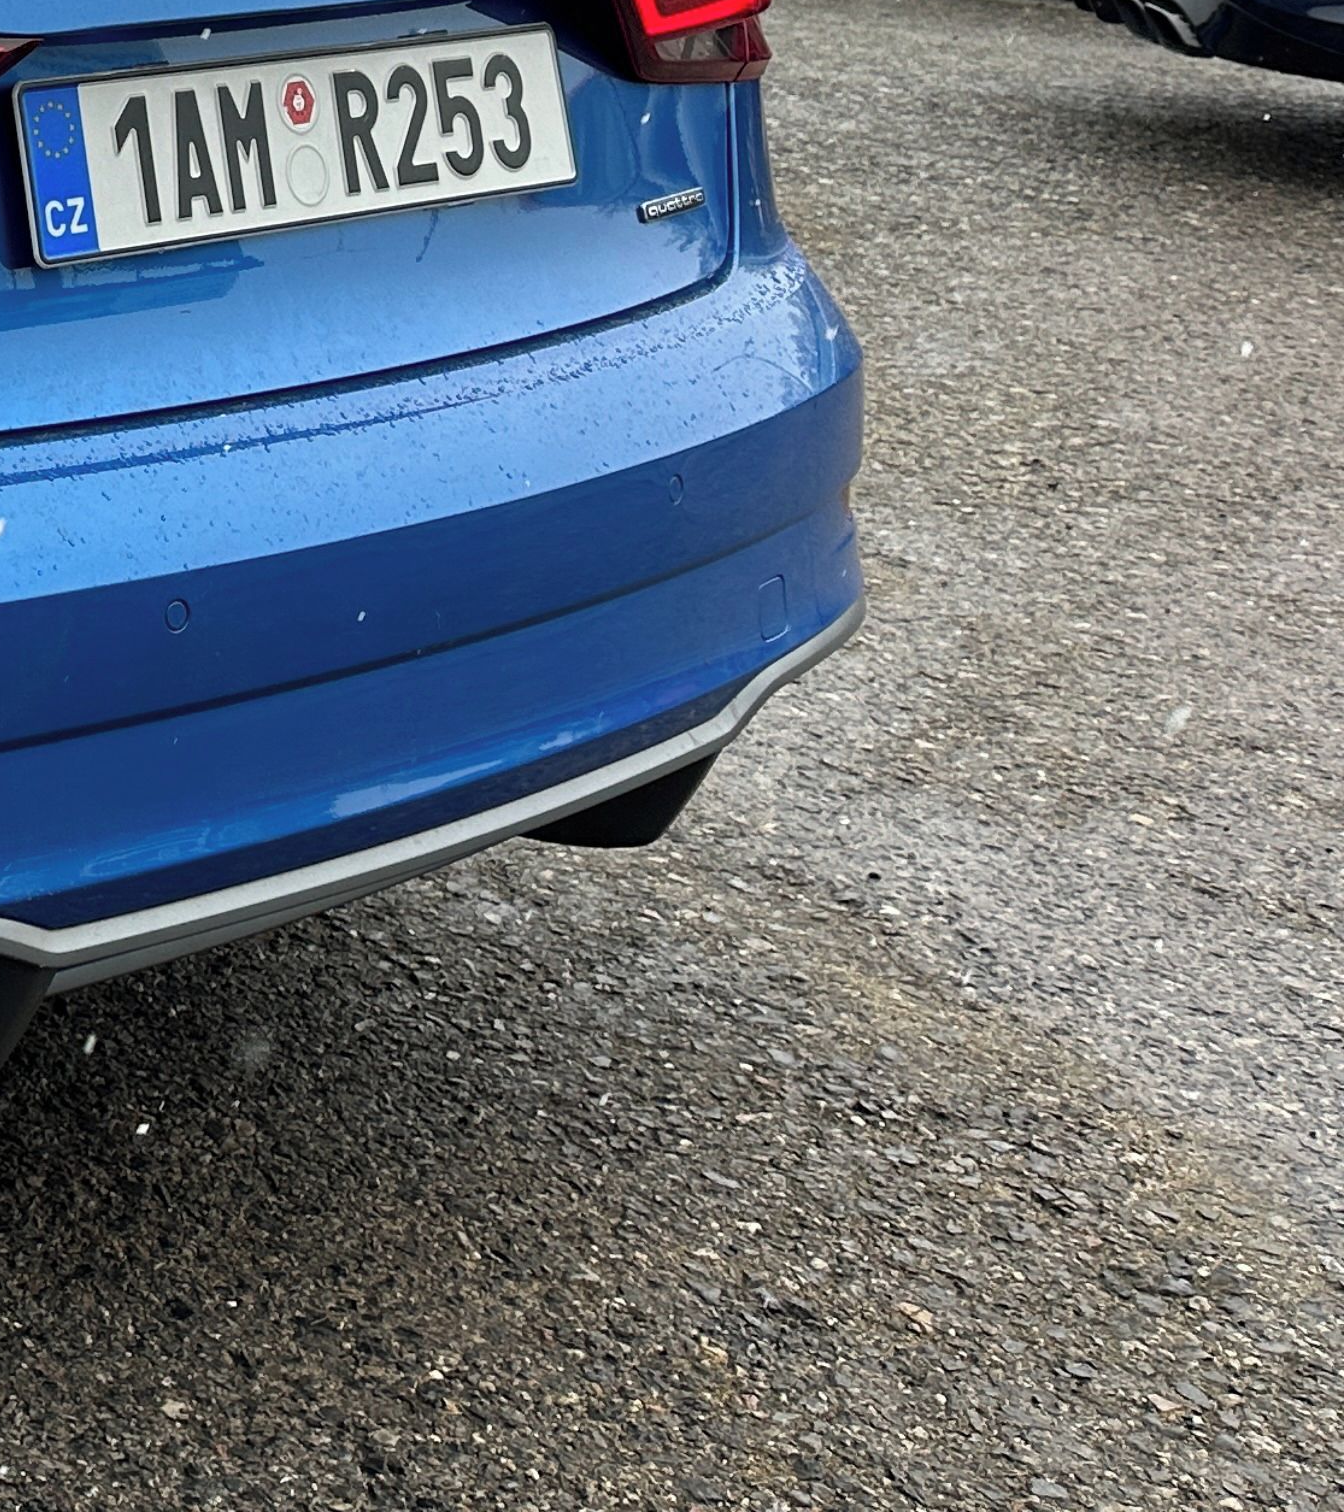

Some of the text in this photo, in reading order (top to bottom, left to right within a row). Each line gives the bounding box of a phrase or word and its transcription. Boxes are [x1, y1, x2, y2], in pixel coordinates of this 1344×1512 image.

[113, 54, 533, 226] 1AM R253
[44, 196, 89, 239] CZ
[647, 192, 704, 217] quattro
